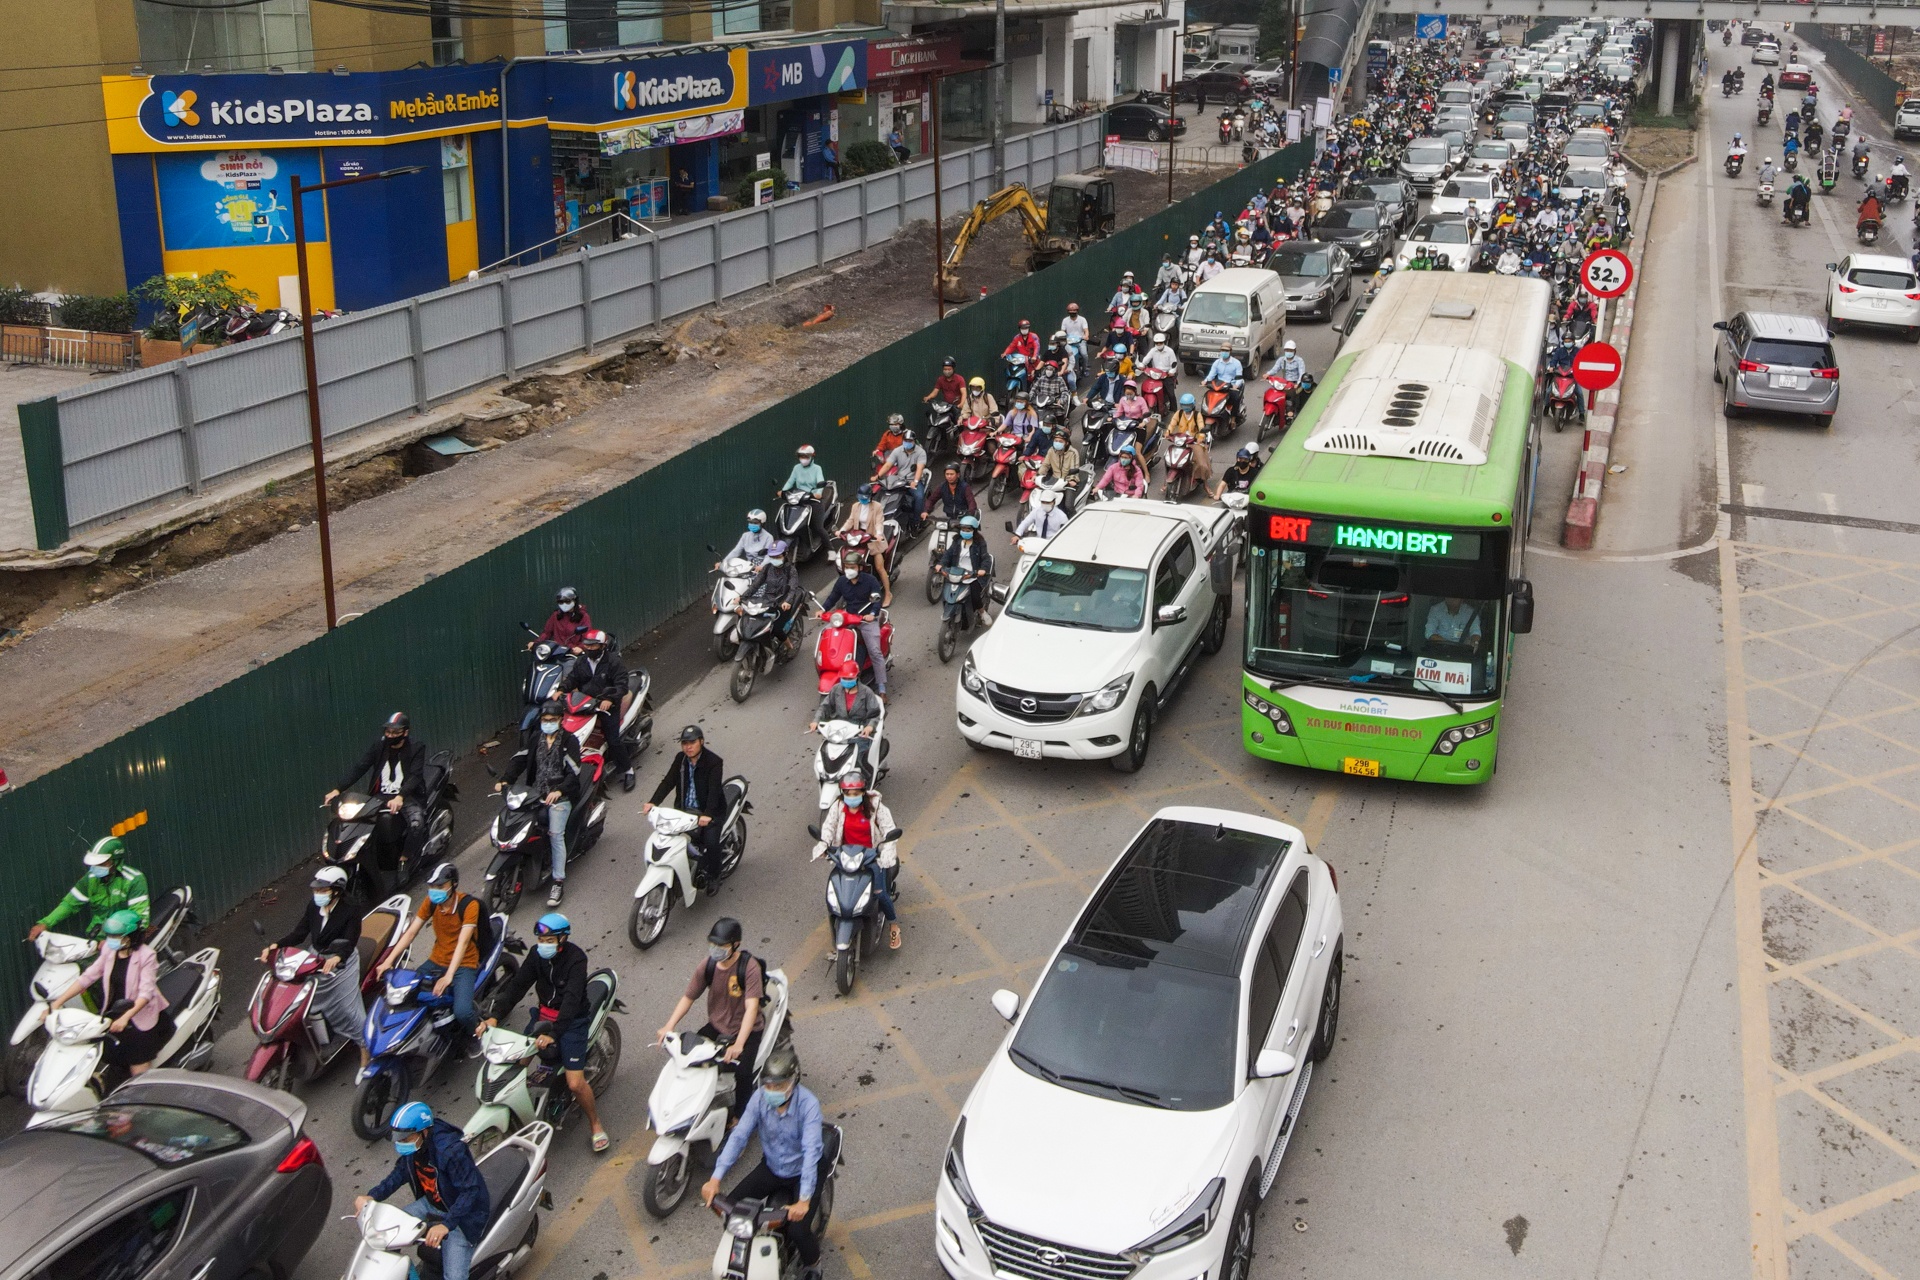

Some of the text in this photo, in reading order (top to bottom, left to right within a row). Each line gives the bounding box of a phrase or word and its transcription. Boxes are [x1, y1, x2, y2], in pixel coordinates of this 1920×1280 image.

[900, 50, 937, 65] AGRIBANK
[781, 62, 803, 86] MB
[638, 75, 722, 107] KidsPlaza
[906, 89, 916, 99] ATM
[210, 99, 373, 125] KidsPlaza
[219, 162, 244, 171] SINH
[1270, 515, 1453, 555] BRT HANOI BRT
[1416, 667, 1441, 681] KIM
[1339, 703, 1389, 715] HANOI BRT
[1323, 719, 1343, 730] BUS
[1020, 740, 1034, 749] 29C
[1354, 759, 1370, 768] 29B
[1348, 766, 1376, 776] 154.56
